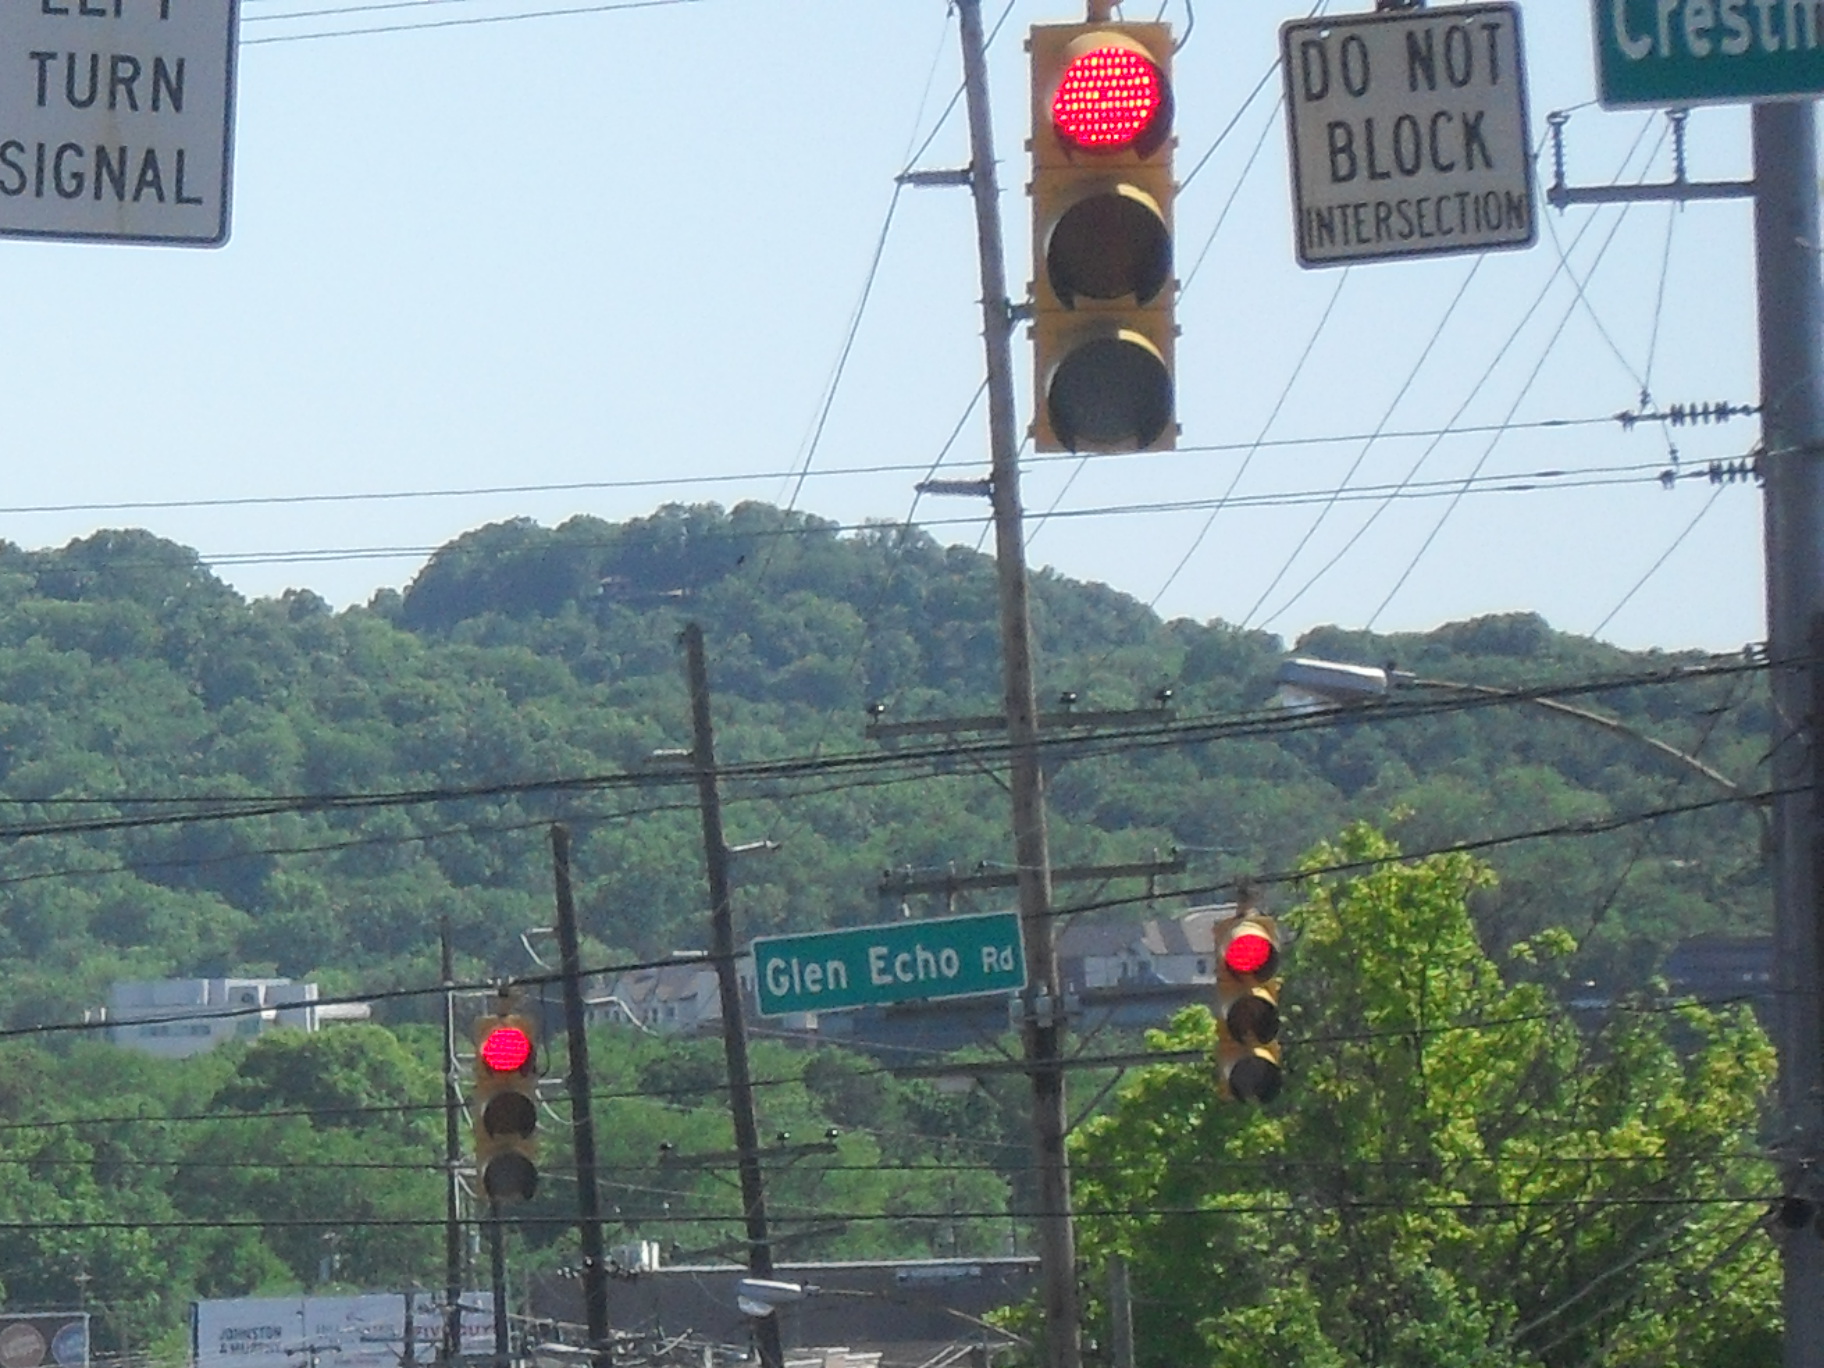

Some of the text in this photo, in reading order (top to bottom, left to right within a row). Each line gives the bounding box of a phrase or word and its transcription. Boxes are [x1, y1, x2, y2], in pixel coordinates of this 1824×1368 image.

[29, 51, 185, 113] TURN
[1300, 22, 1502, 102] DO NOT
[1327, 110, 1494, 184] BLOCK
[1305, 191, 1526, 250] INTERSECTION
[766, 944, 1014, 997] Glen Echo Rd
